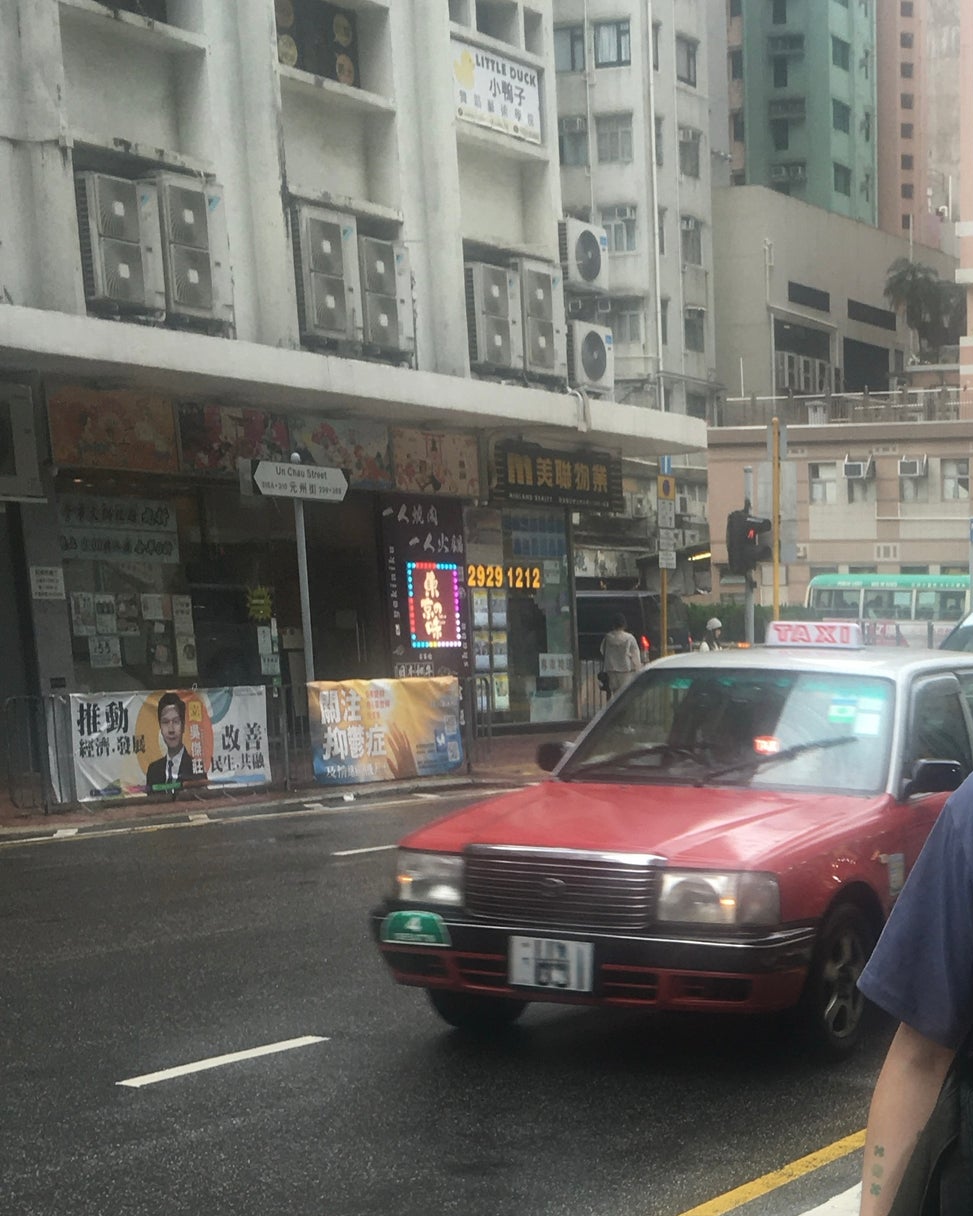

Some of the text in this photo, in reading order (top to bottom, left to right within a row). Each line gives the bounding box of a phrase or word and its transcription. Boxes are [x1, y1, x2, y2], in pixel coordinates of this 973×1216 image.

[475, 53, 537, 88] LITTLE DUCK
[489, 77, 526, 106] 小鴨子
[275, 466, 328, 480] Un Chau Street
[535, 456, 608, 493] 美聯物業
[289, 481, 317, 495] 元州街
[467, 564, 541, 588] 2929 1212
[772, 623, 852, 644] TAXI
[76, 701, 130, 737] 推動
[319, 688, 362, 725] 關注
[221, 722, 263, 752] 改善
[322, 722, 388, 762] 抑鬱症
[404, 917, 423, 932] 4
